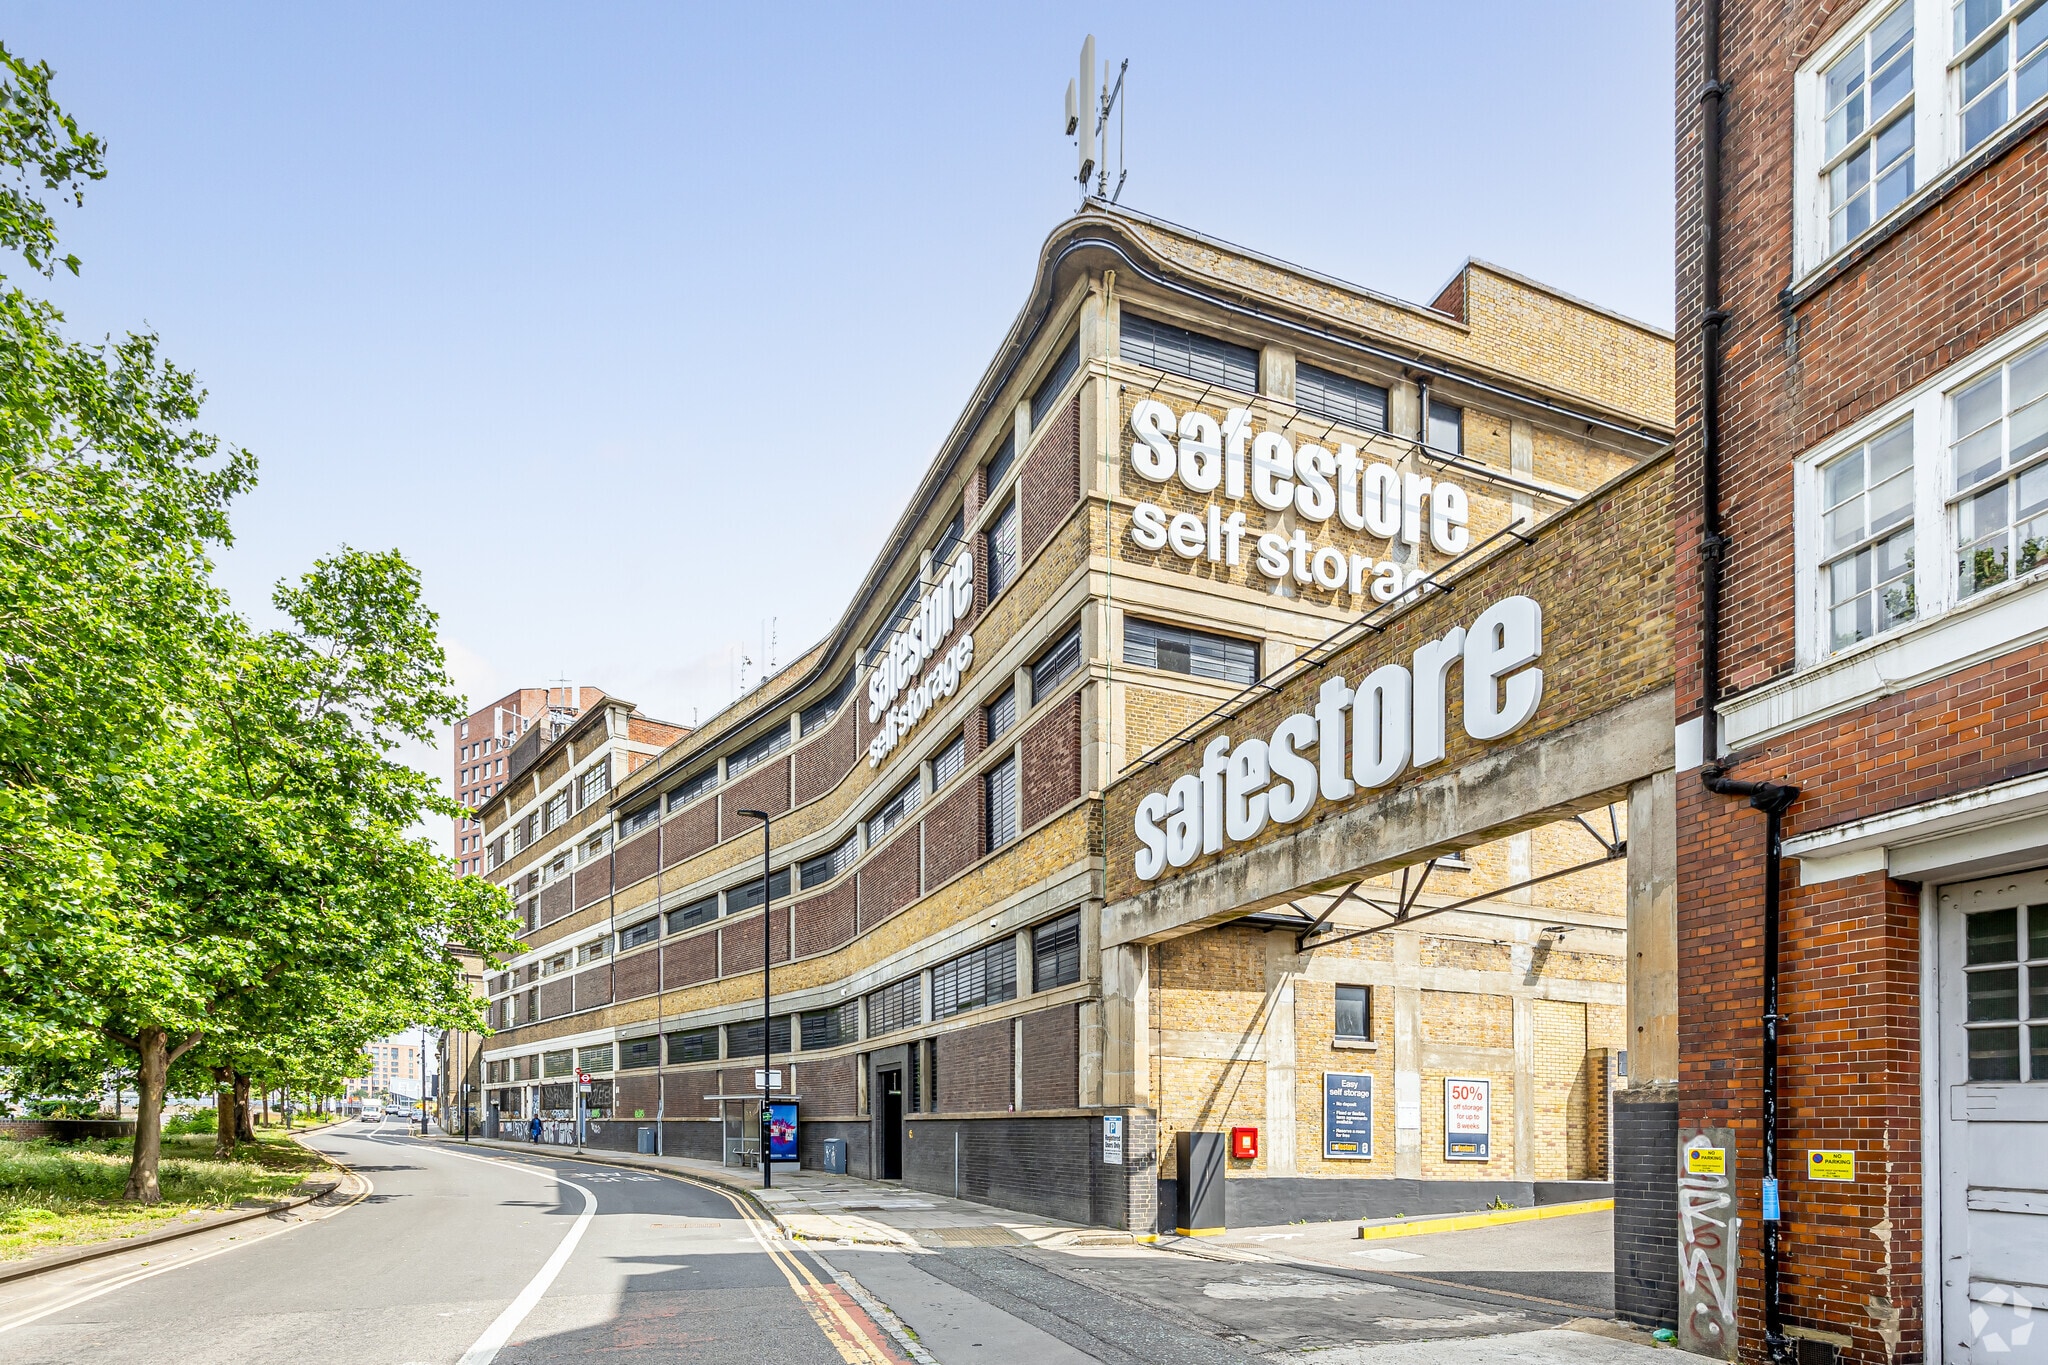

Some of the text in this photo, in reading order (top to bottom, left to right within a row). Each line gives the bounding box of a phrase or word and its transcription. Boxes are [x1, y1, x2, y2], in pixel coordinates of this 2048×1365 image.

[1130, 399, 1471, 556] safestore
[1131, 502, 1247, 567] self
[869, 551, 973, 724] safestore
[869, 634, 974, 769] self storage
[1134, 595, 1543, 881] safestore
[1342, 1080, 1358, 1089] Easy
[1344, 1089, 1369, 1098] storage
[1452, 1086, 1482, 1100] 50%
